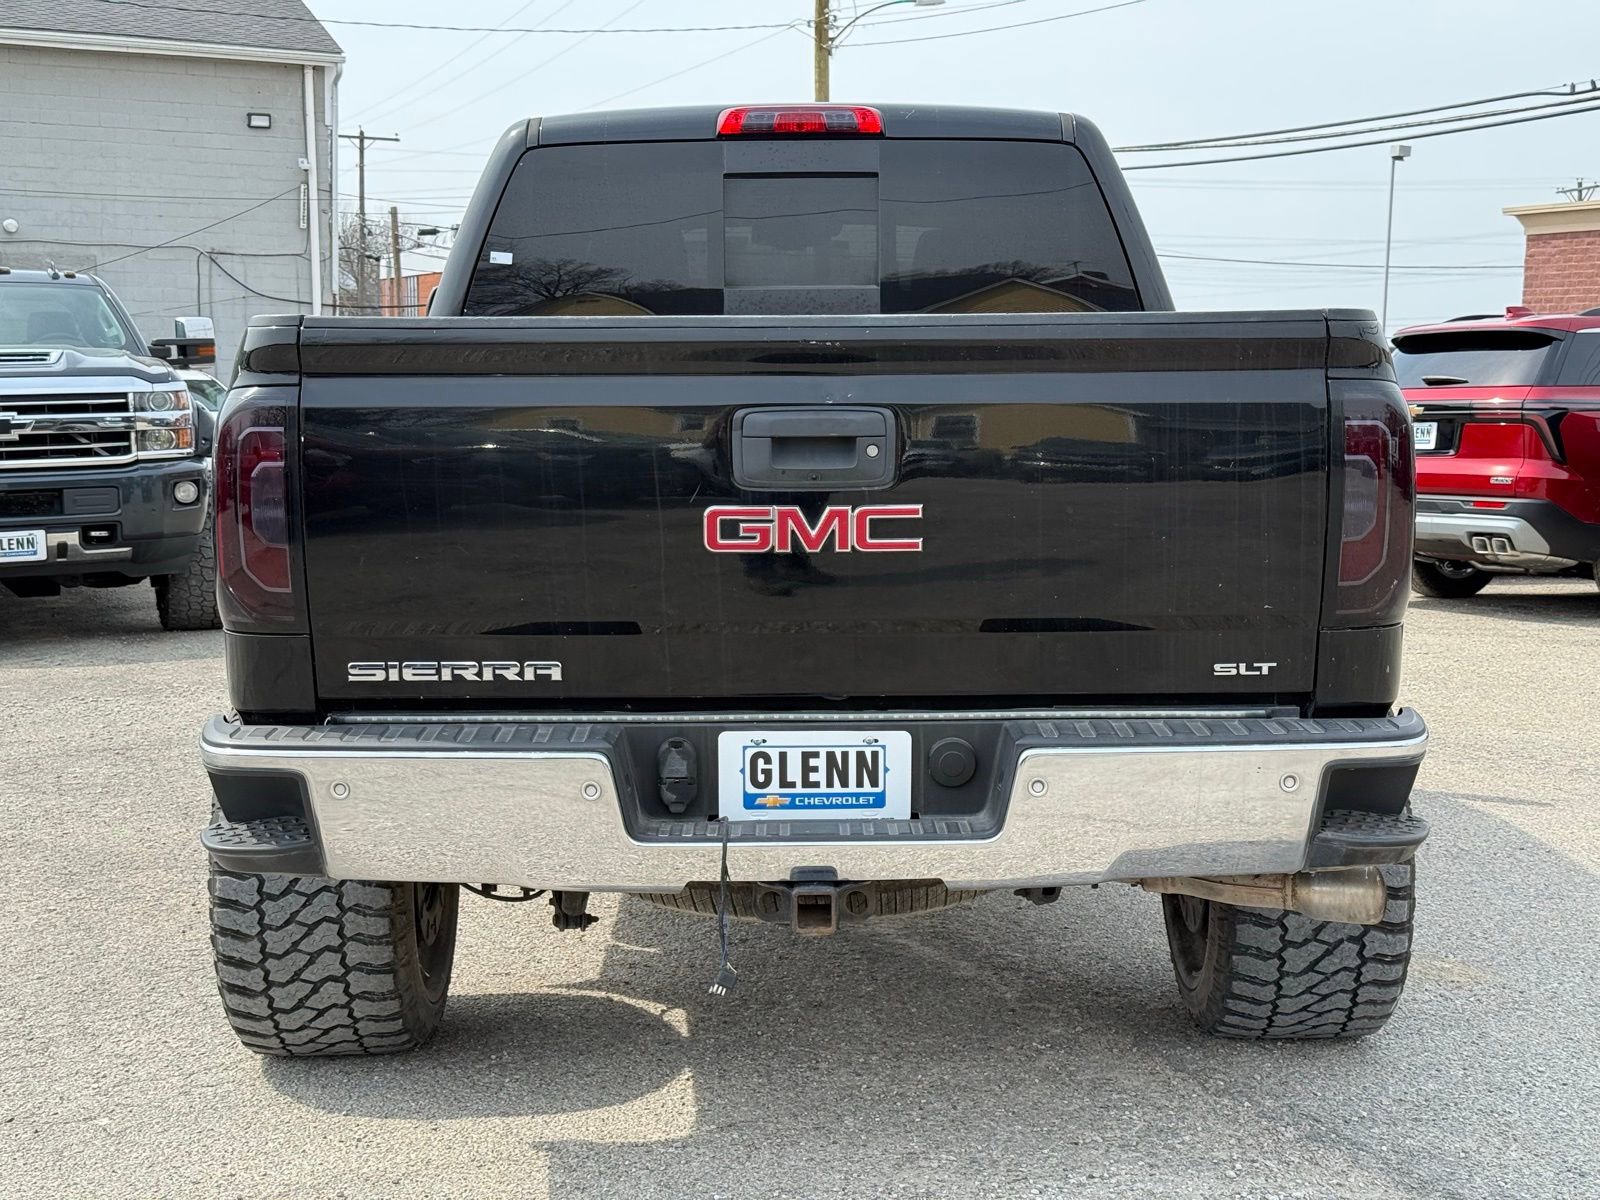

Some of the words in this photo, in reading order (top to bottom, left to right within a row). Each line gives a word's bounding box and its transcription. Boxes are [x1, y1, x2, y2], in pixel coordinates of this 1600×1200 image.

[703, 504, 924, 553] GMC
[347, 661, 563, 682] SIERRA
[1213, 662, 1278, 676] SLT
[749, 750, 880, 790] GLENN
[795, 796, 876, 805] CHEVROLET
